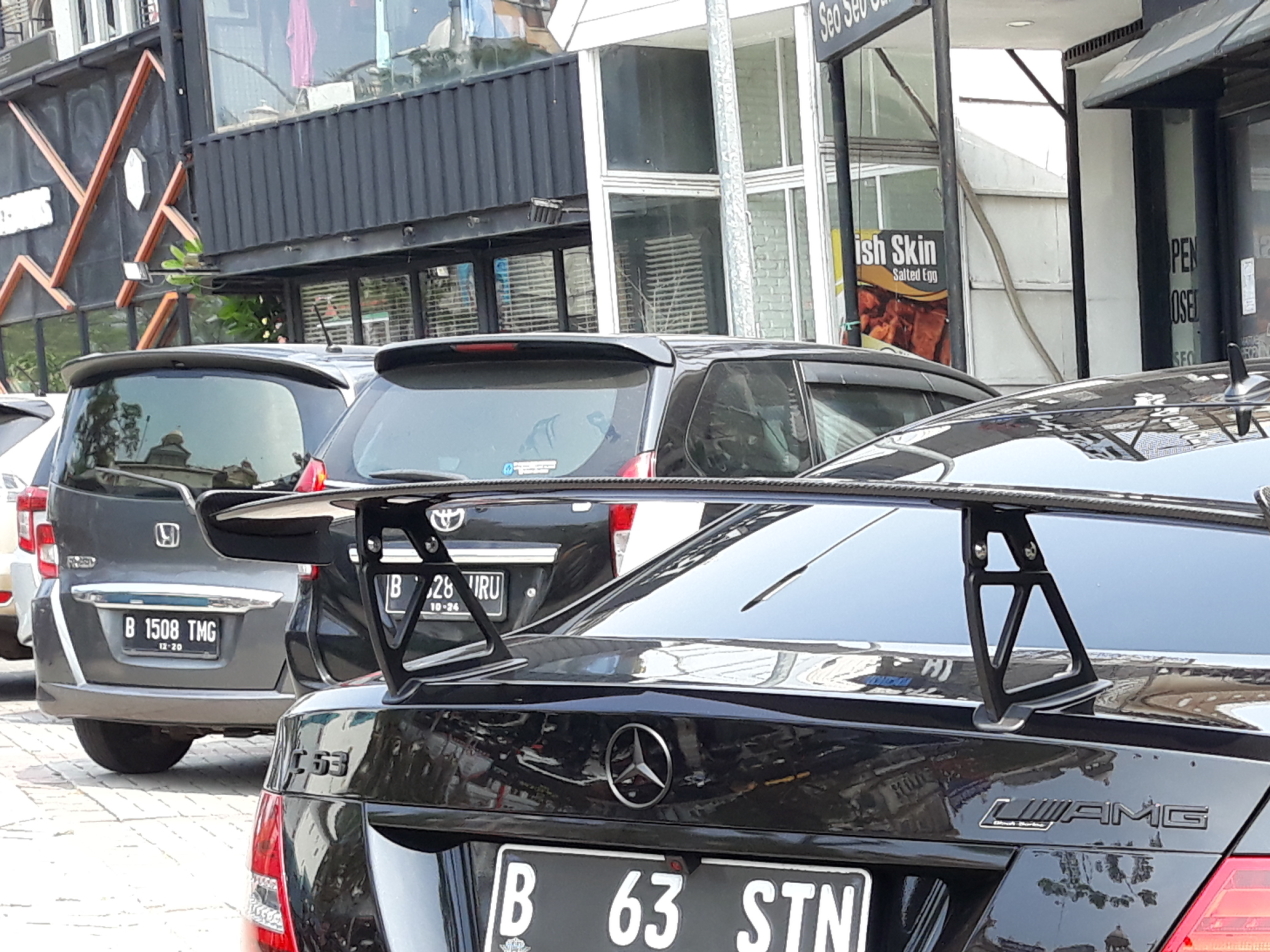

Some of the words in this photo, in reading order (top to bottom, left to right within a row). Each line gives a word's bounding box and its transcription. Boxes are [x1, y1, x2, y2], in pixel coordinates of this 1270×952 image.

[819, 2, 842, 42] Seo
[855, 234, 887, 265] ish
[891, 234, 937, 266] Skin
[1171, 237, 1198, 273] PEN
[893, 268, 920, 281] Salted
[922, 268, 938, 284] Egg
[390, 574, 402, 599] B
[415, 574, 454, 599] 28
[125, 616, 136, 639] B
[145, 617, 180, 641] 1508
[187, 619, 217, 643] TMG
[290, 748, 308, 775] C
[311, 750, 350, 778] 63
[1060, 800, 1209, 831] AMG
[499, 861, 537, 938] B
[608, 869, 683, 951] 63
